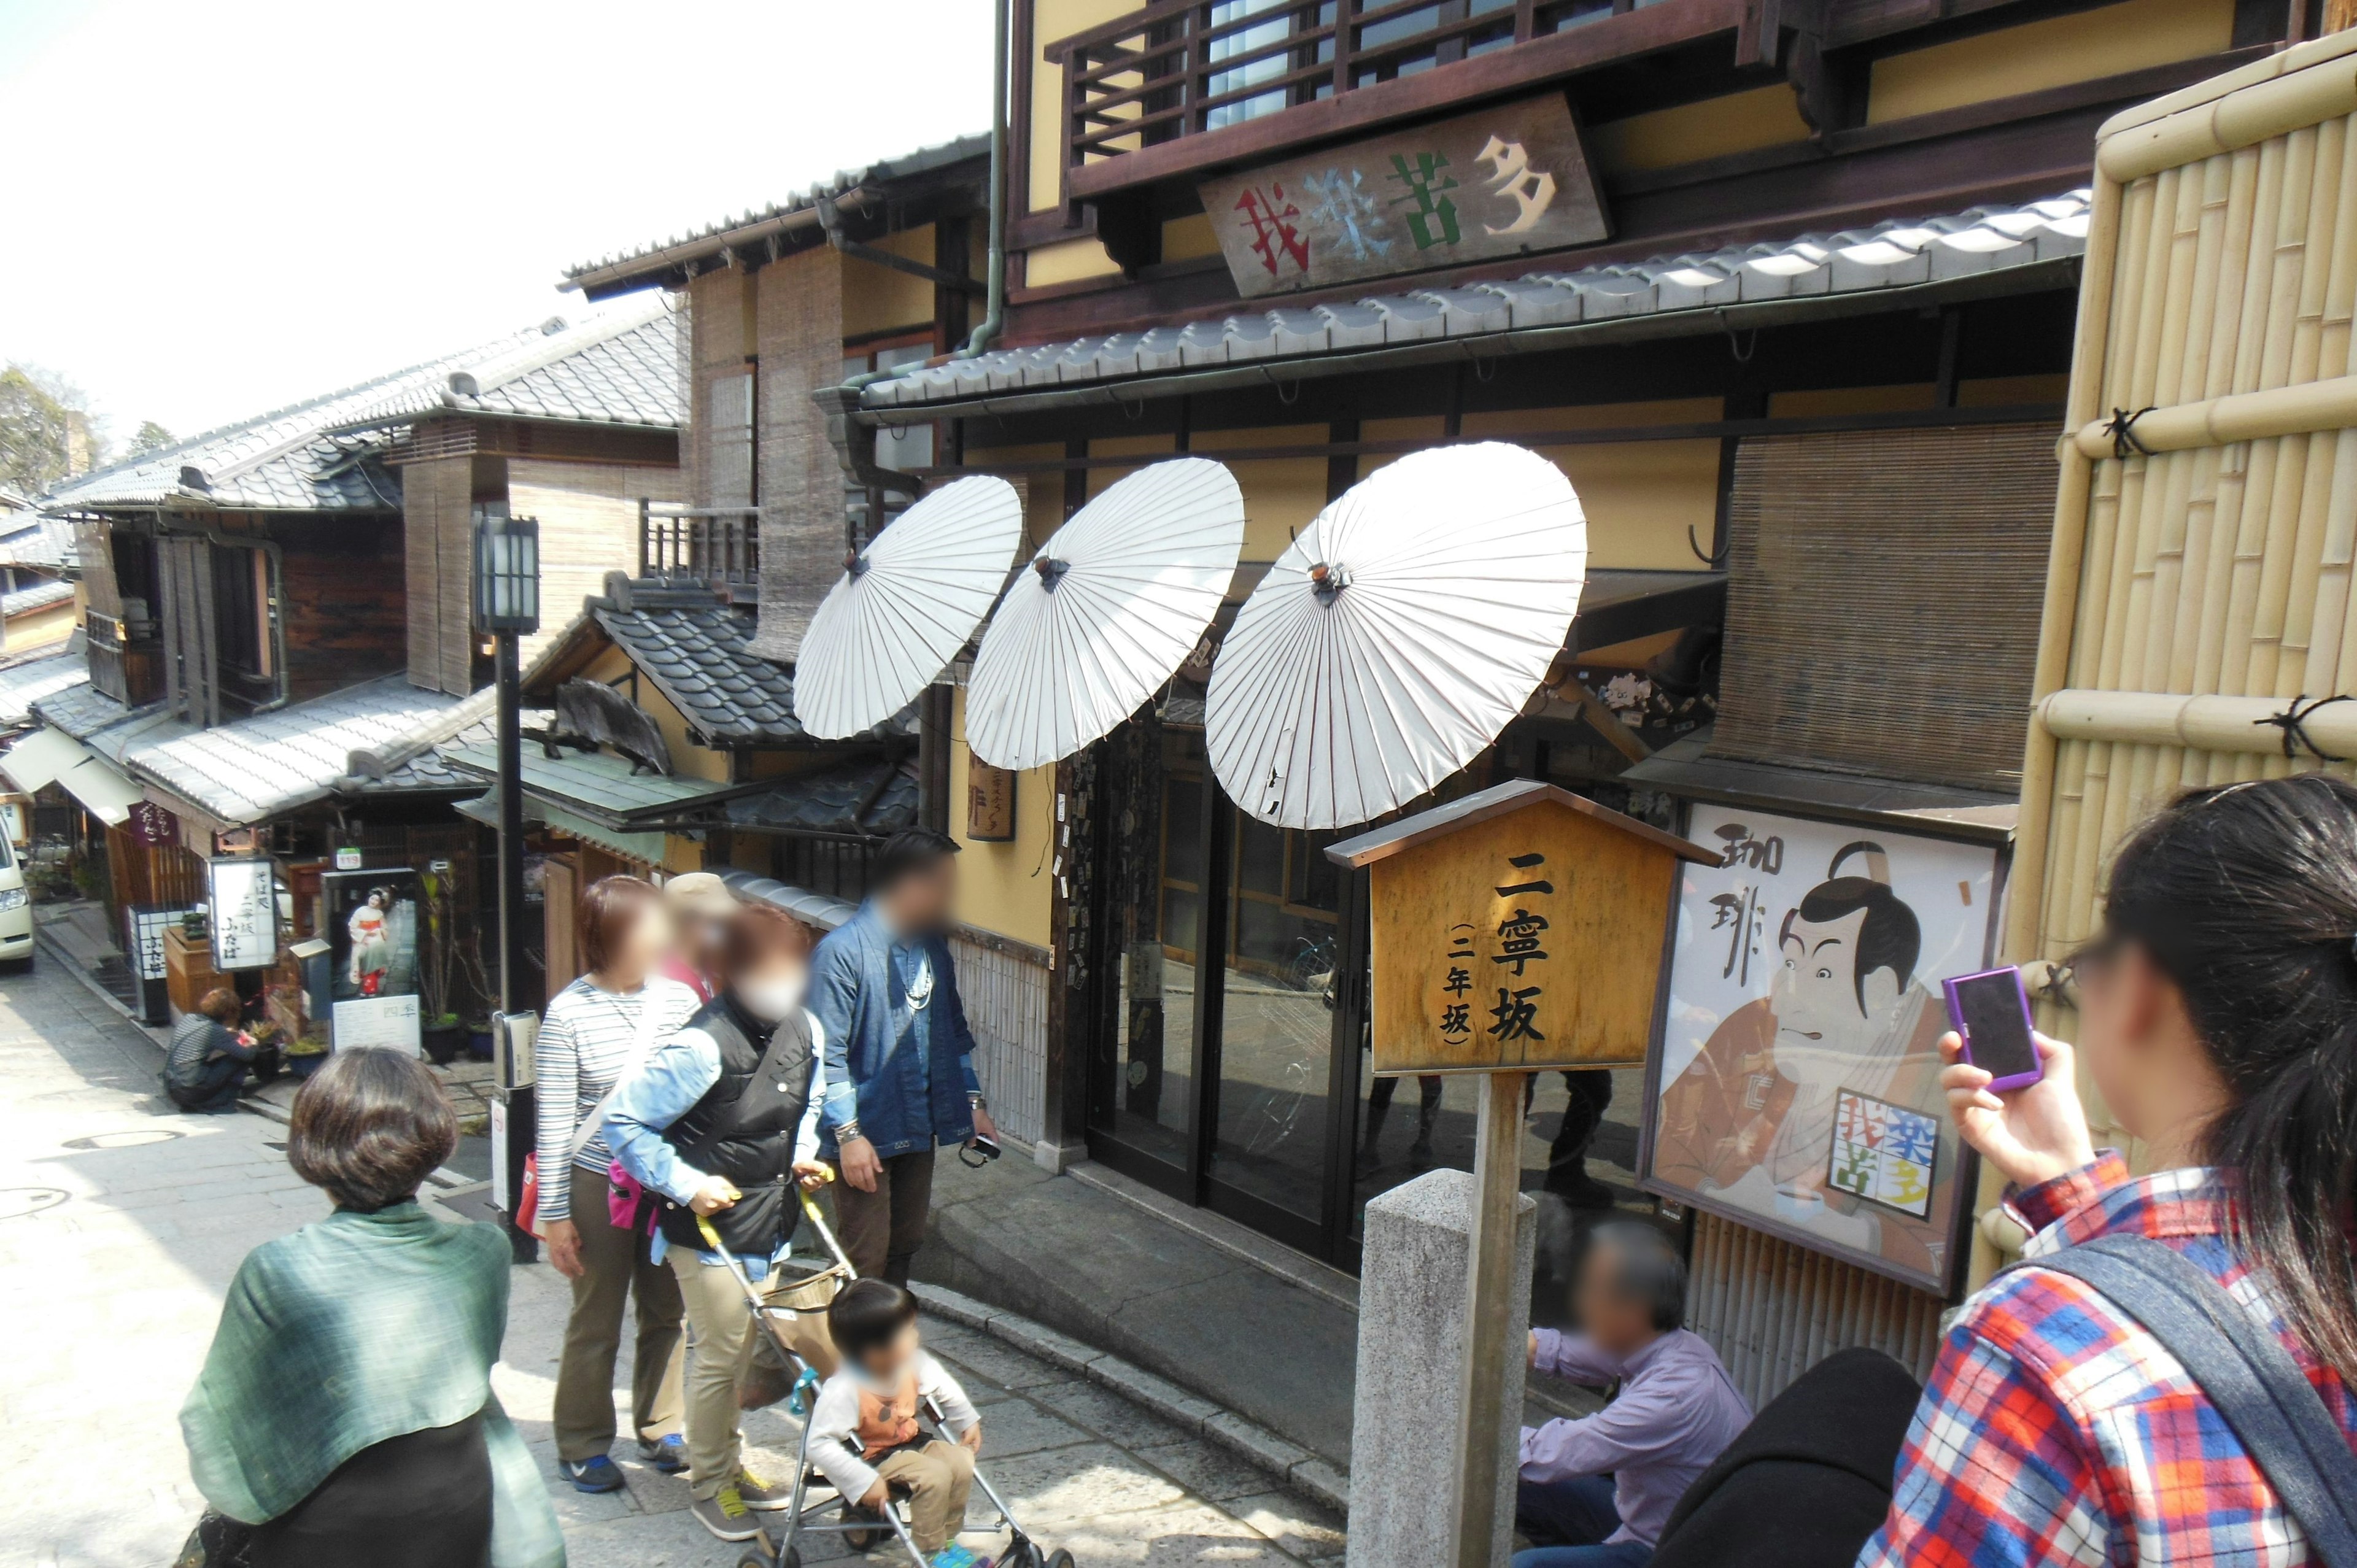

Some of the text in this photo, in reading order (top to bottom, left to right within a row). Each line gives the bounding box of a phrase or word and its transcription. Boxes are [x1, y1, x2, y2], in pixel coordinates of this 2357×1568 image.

[221, 917, 241, 959] ふたば
[255, 871, 269, 909] そば処
[1709, 823, 1784, 987] 珈琲
[1487, 852, 1554, 1041] 二寧坂
